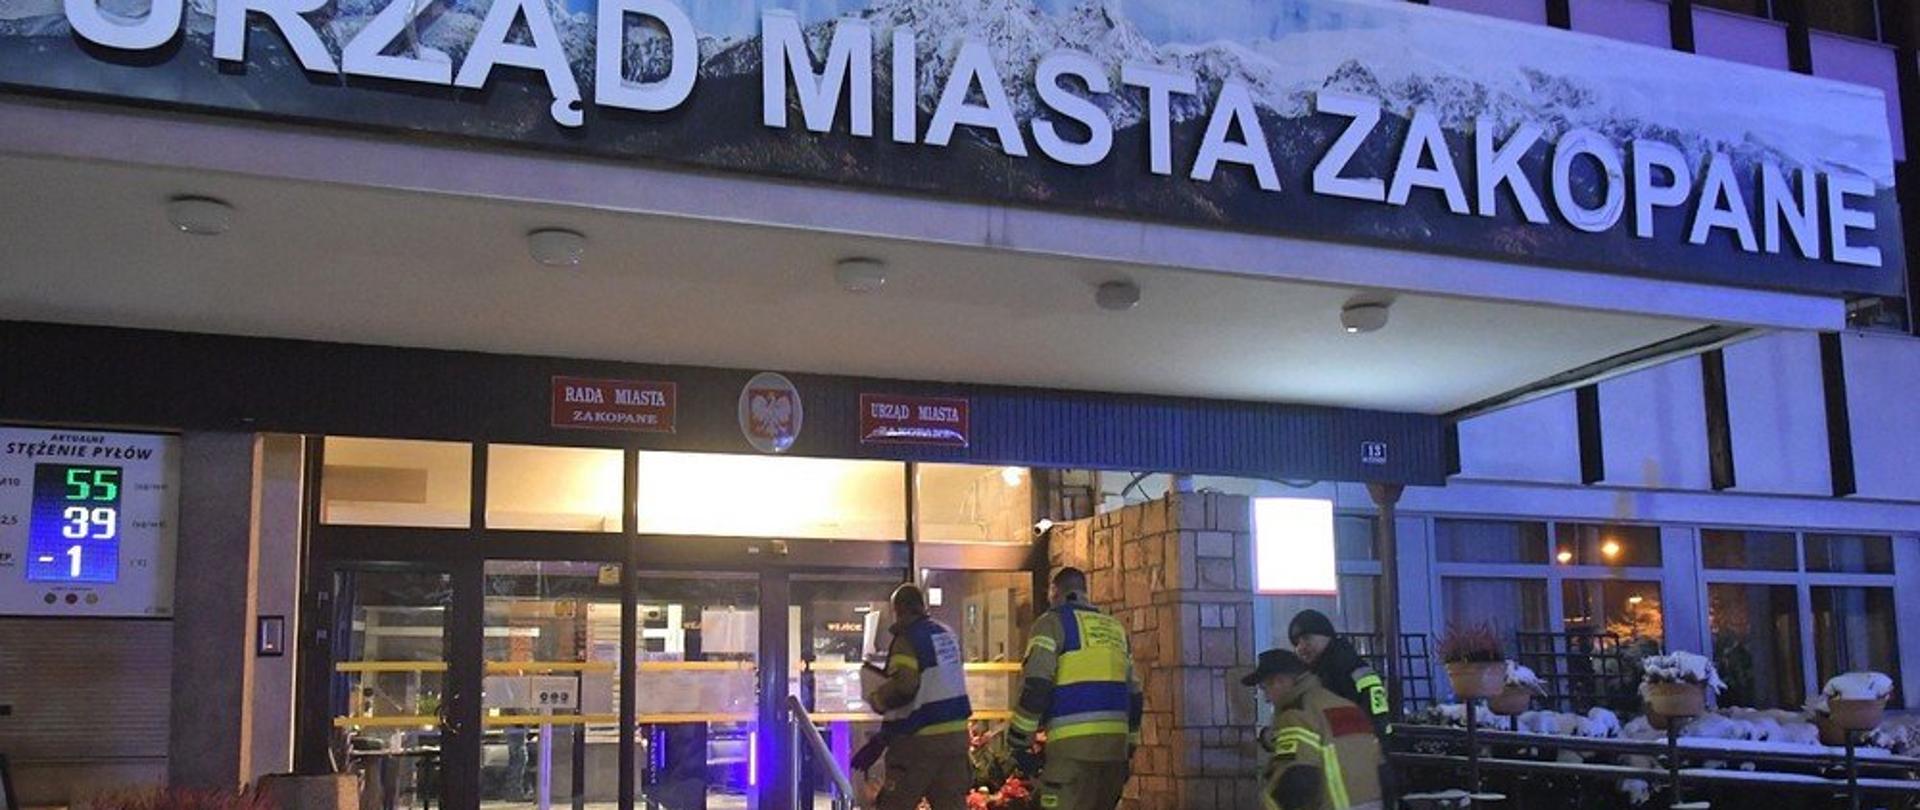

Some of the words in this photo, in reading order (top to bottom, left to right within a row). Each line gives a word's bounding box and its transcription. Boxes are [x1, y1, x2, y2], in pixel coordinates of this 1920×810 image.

[762, 11, 1282, 191] MIASTA
[1313, 95, 1882, 267] ZAKOPANE
[565, 387, 603, 403] RADA
[615, 389, 665, 406] MIASTA
[573, 411, 657, 424] ZAKOPANE
[871, 403, 909, 421] URZĄD
[918, 406, 958, 421] MIASTA
[50, 433, 105, 444] AKTUALNE
[6, 440, 87, 458] STĘŻENIE
[92, 445, 152, 460] PYŁÓW
[66, 469, 118, 500] 55
[62, 506, 116, 539] 39
